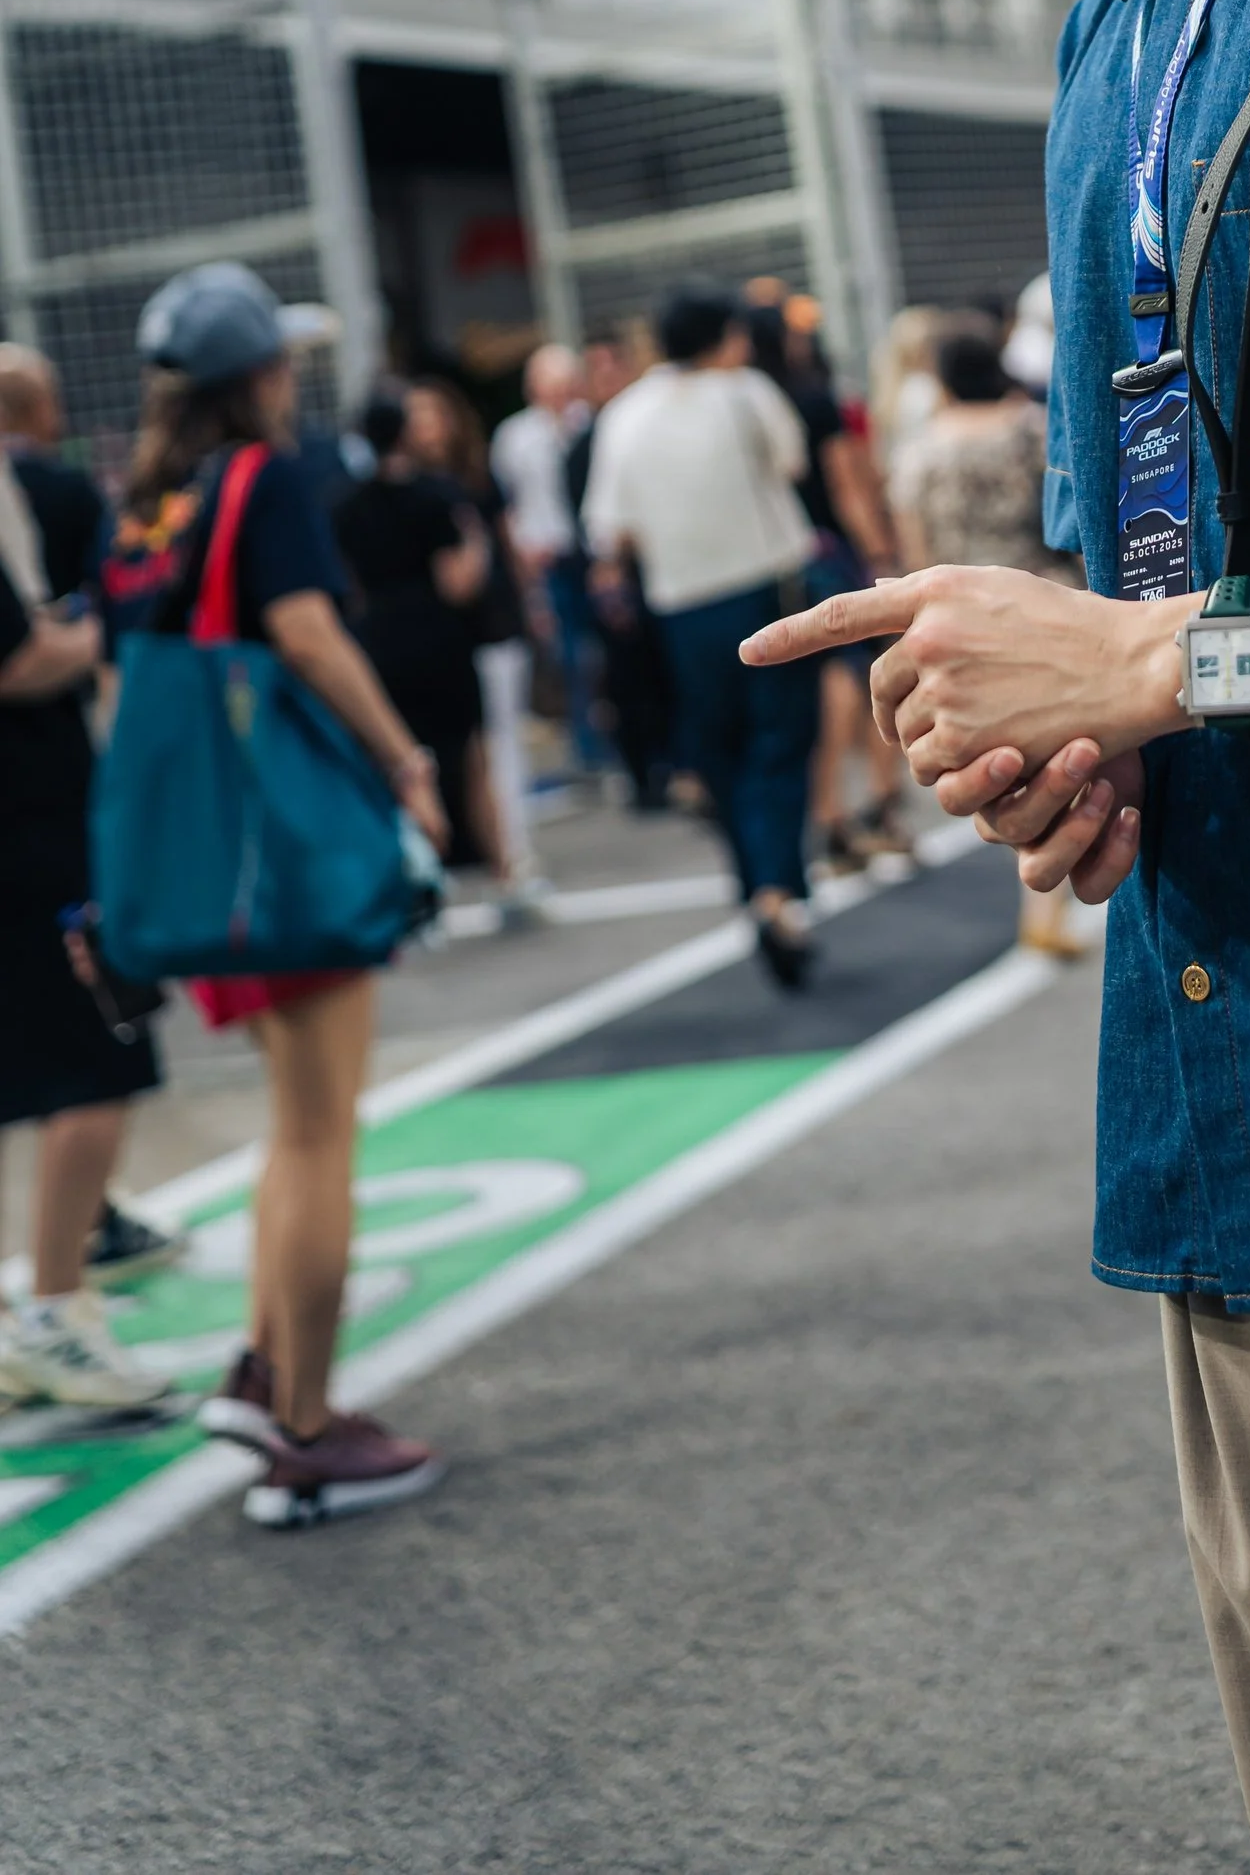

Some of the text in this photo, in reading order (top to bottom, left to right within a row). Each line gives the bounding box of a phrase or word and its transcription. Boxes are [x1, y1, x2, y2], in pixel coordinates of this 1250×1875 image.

[1126, 432, 1180, 457] PADDOCK
[1138, 445, 1168, 461] CLUB
[1131, 463, 1175, 484] SINGAPORE
[1129, 528, 1176, 549] SUNDAY
[1123, 537, 1183, 562] 05.OCT.2025
[1142, 588, 1163, 602] TAG
